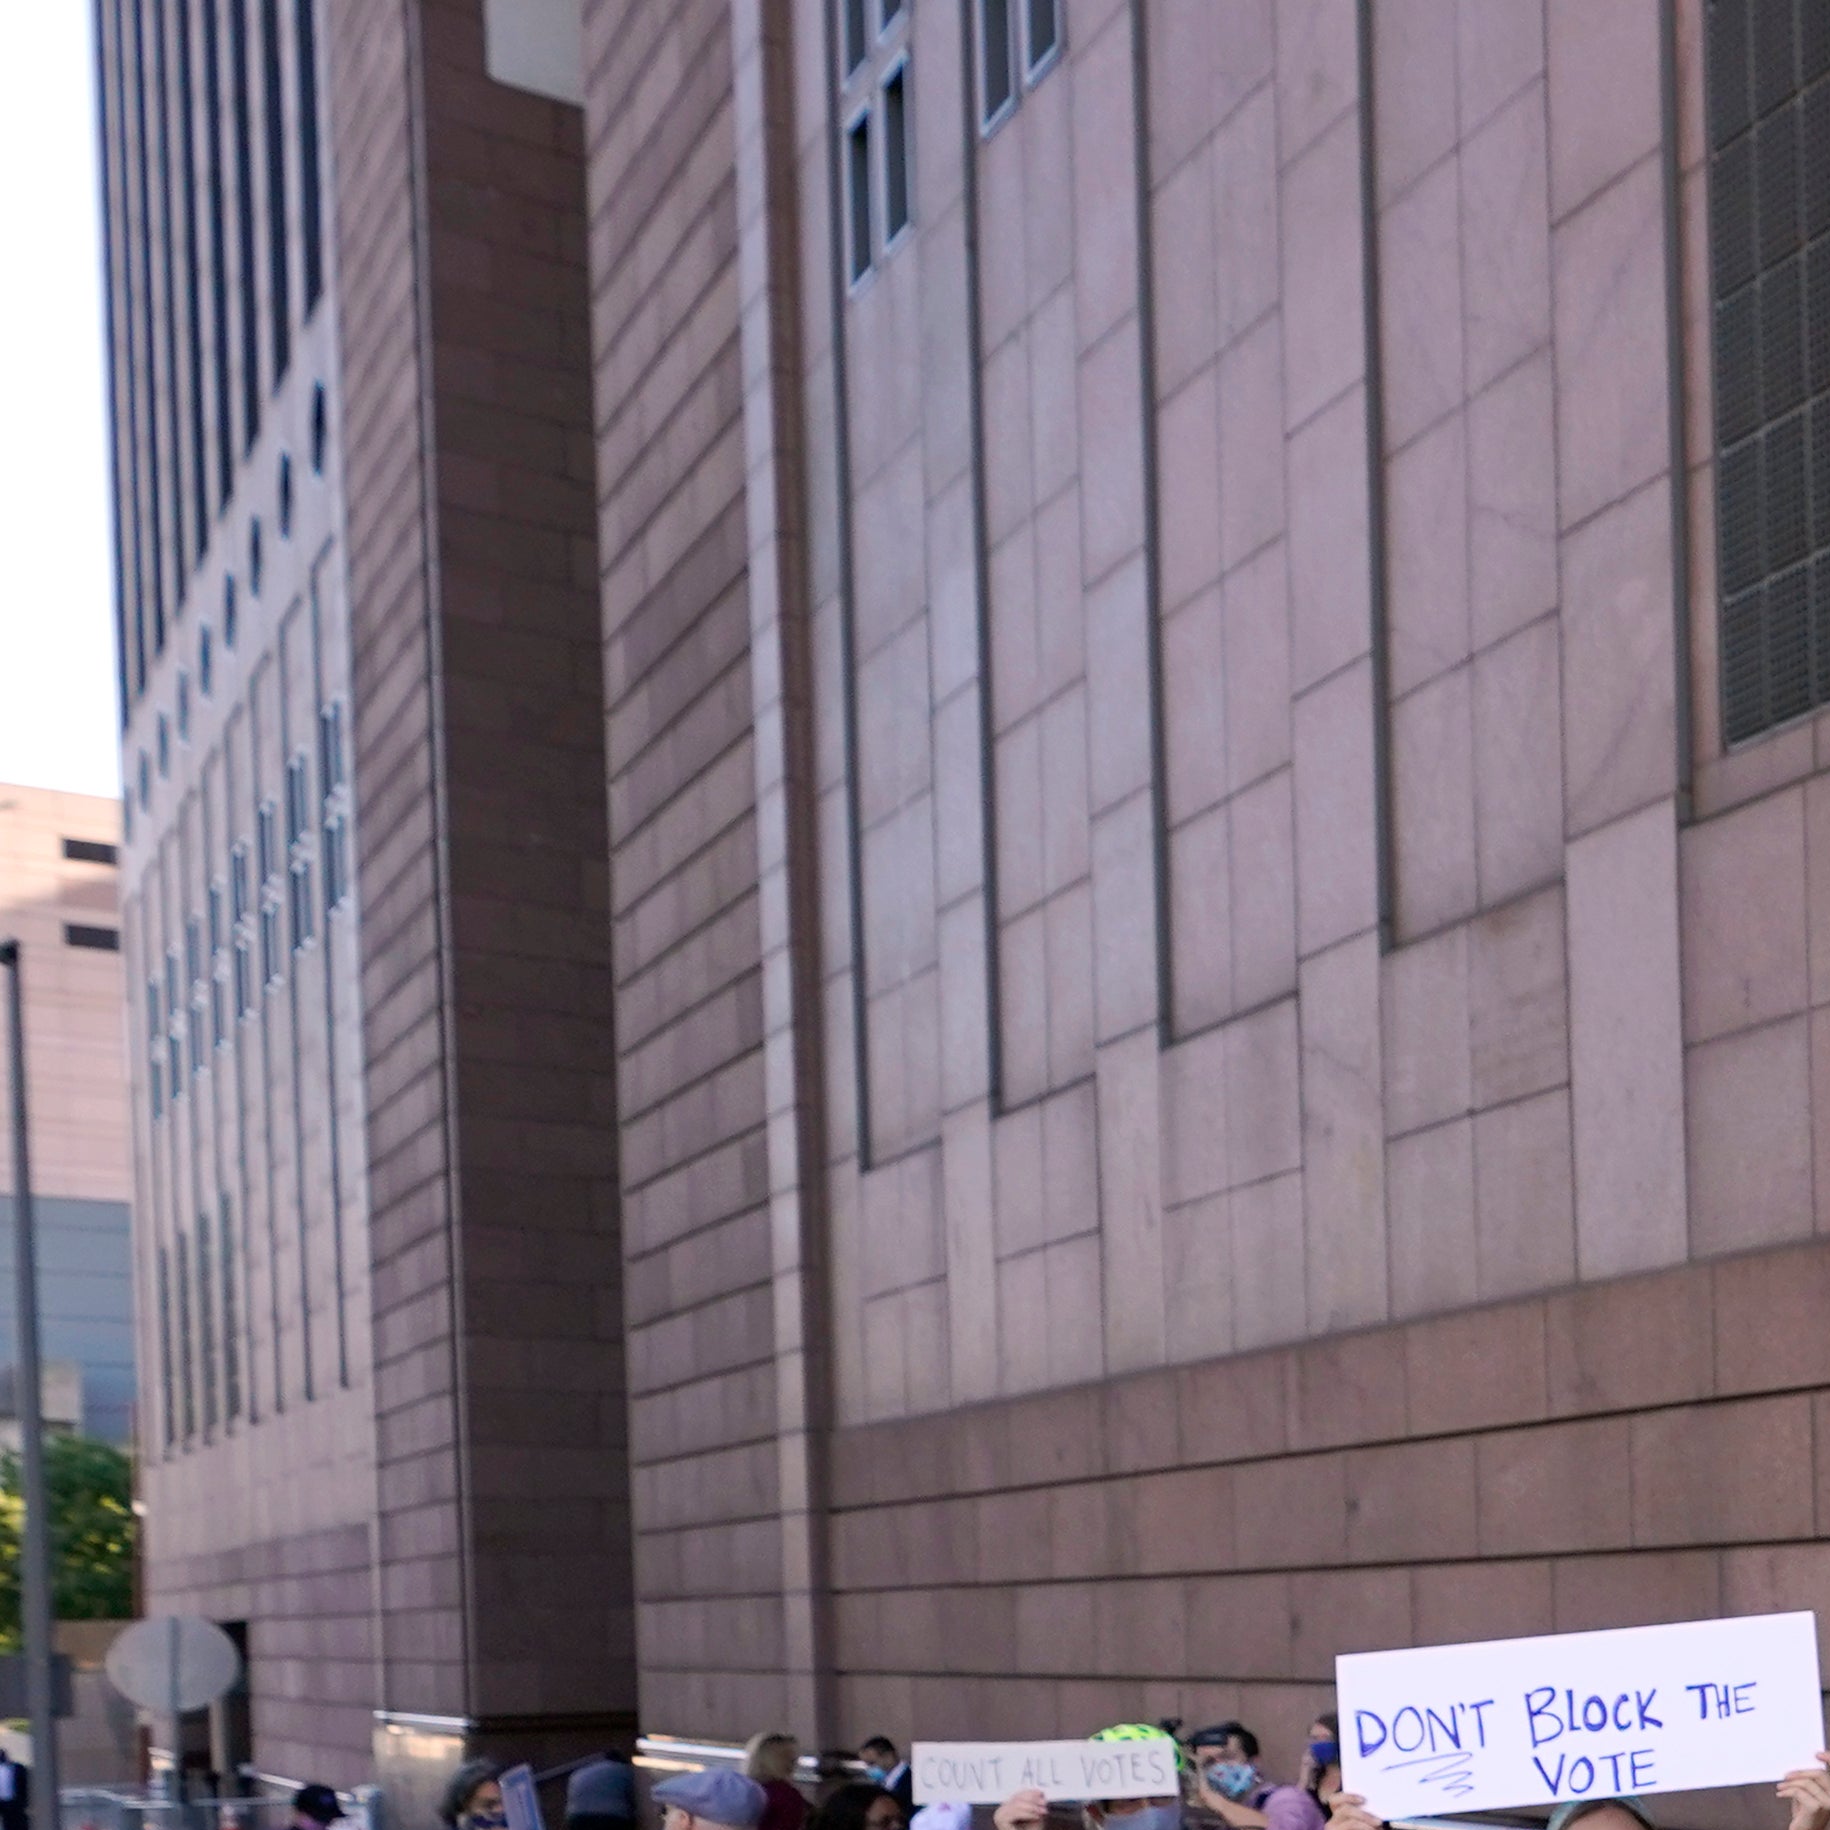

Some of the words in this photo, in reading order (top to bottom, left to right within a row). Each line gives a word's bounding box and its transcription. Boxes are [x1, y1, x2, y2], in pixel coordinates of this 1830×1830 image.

[1355, 1699, 1494, 1757] DON'T
[1685, 1682, 1757, 1720] THE
[920, 1756, 1004, 1791] COUNT
[1020, 1756, 1064, 1787] ALL
[1080, 1751, 1166, 1788] VOTES
[1533, 1749, 1658, 1797] VOTE
